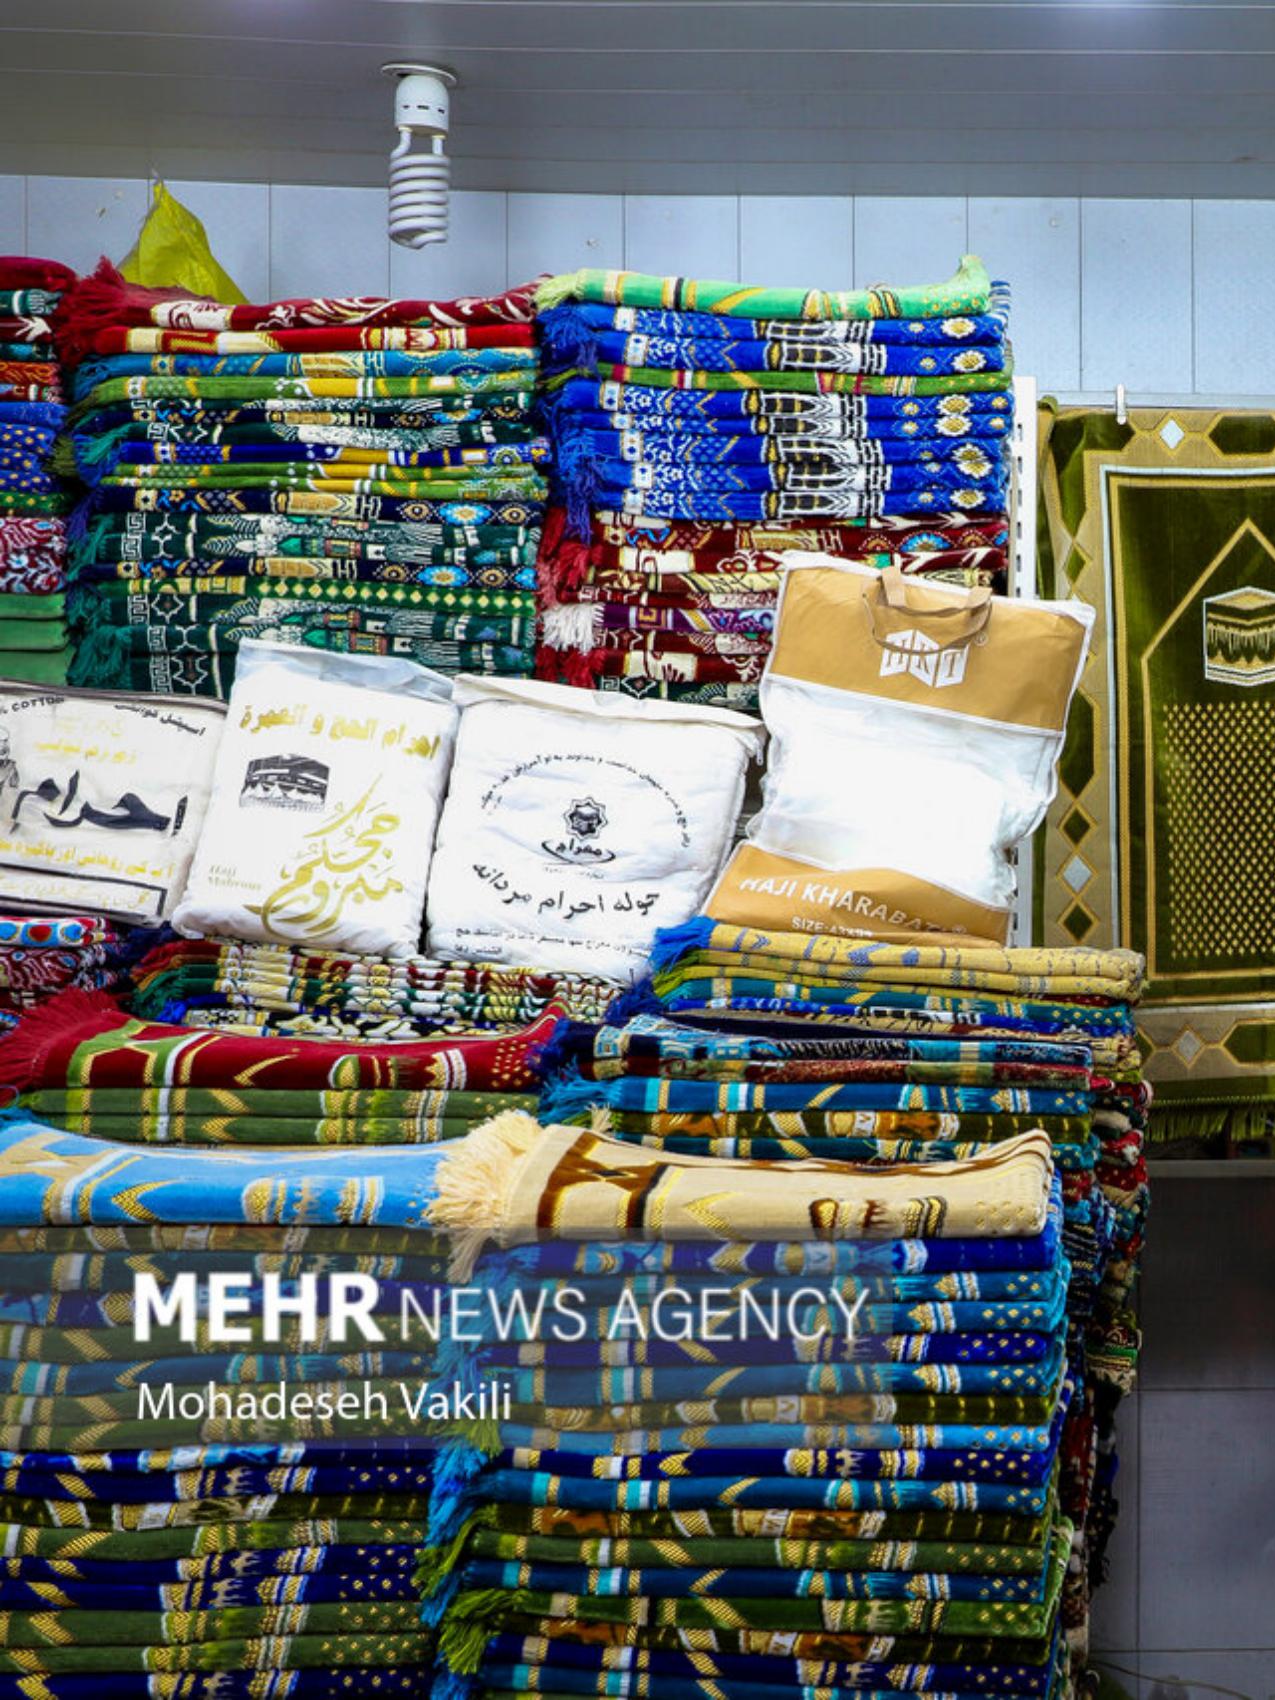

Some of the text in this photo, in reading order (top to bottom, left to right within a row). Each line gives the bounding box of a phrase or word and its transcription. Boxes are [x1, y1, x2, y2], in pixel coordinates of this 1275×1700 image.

[309, 713, 325, 735] و
[9, 769, 189, 836] احرام
[473, 863, 532, 904] مردانه
[537, 890, 605, 919] احرام
[739, 877, 947, 932] HAJI KHARABA
